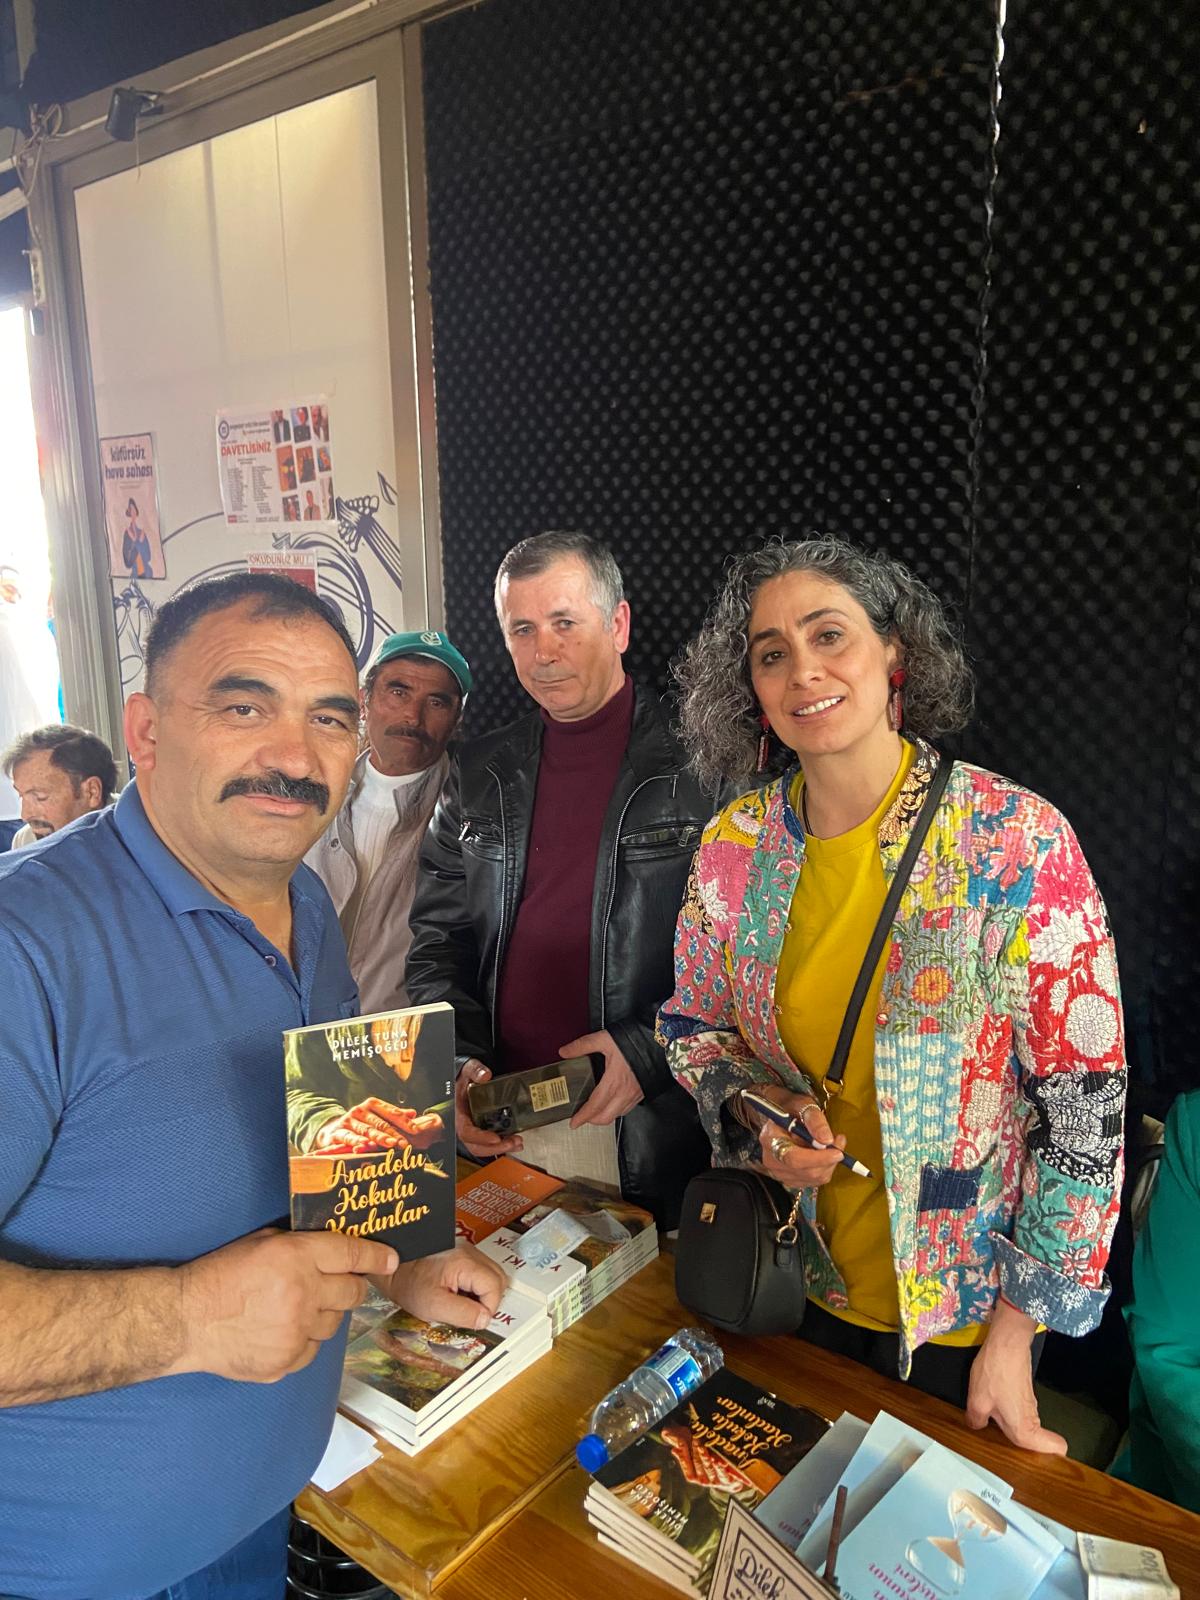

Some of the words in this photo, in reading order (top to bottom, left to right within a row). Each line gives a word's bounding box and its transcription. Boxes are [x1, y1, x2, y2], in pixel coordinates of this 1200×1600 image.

[220, 440, 272, 457] DAVETLİSİNİZ
[332, 1034, 370, 1050] DİLEK
[375, 1030, 408, 1043] TUNA
[332, 1038, 409, 1062] MEMİŞOĞLU
[326, 1144, 427, 1187] Anadolu
[334, 1173, 417, 1216] Kokulu
[325, 1201, 431, 1238] Kadınlar
[712, 1412, 770, 1455] Kokulu
[717, 1396, 792, 1448] Kadınlar
[691, 1420, 754, 1469] Anadolu
[736, 1547, 786, 1600] Dilek
